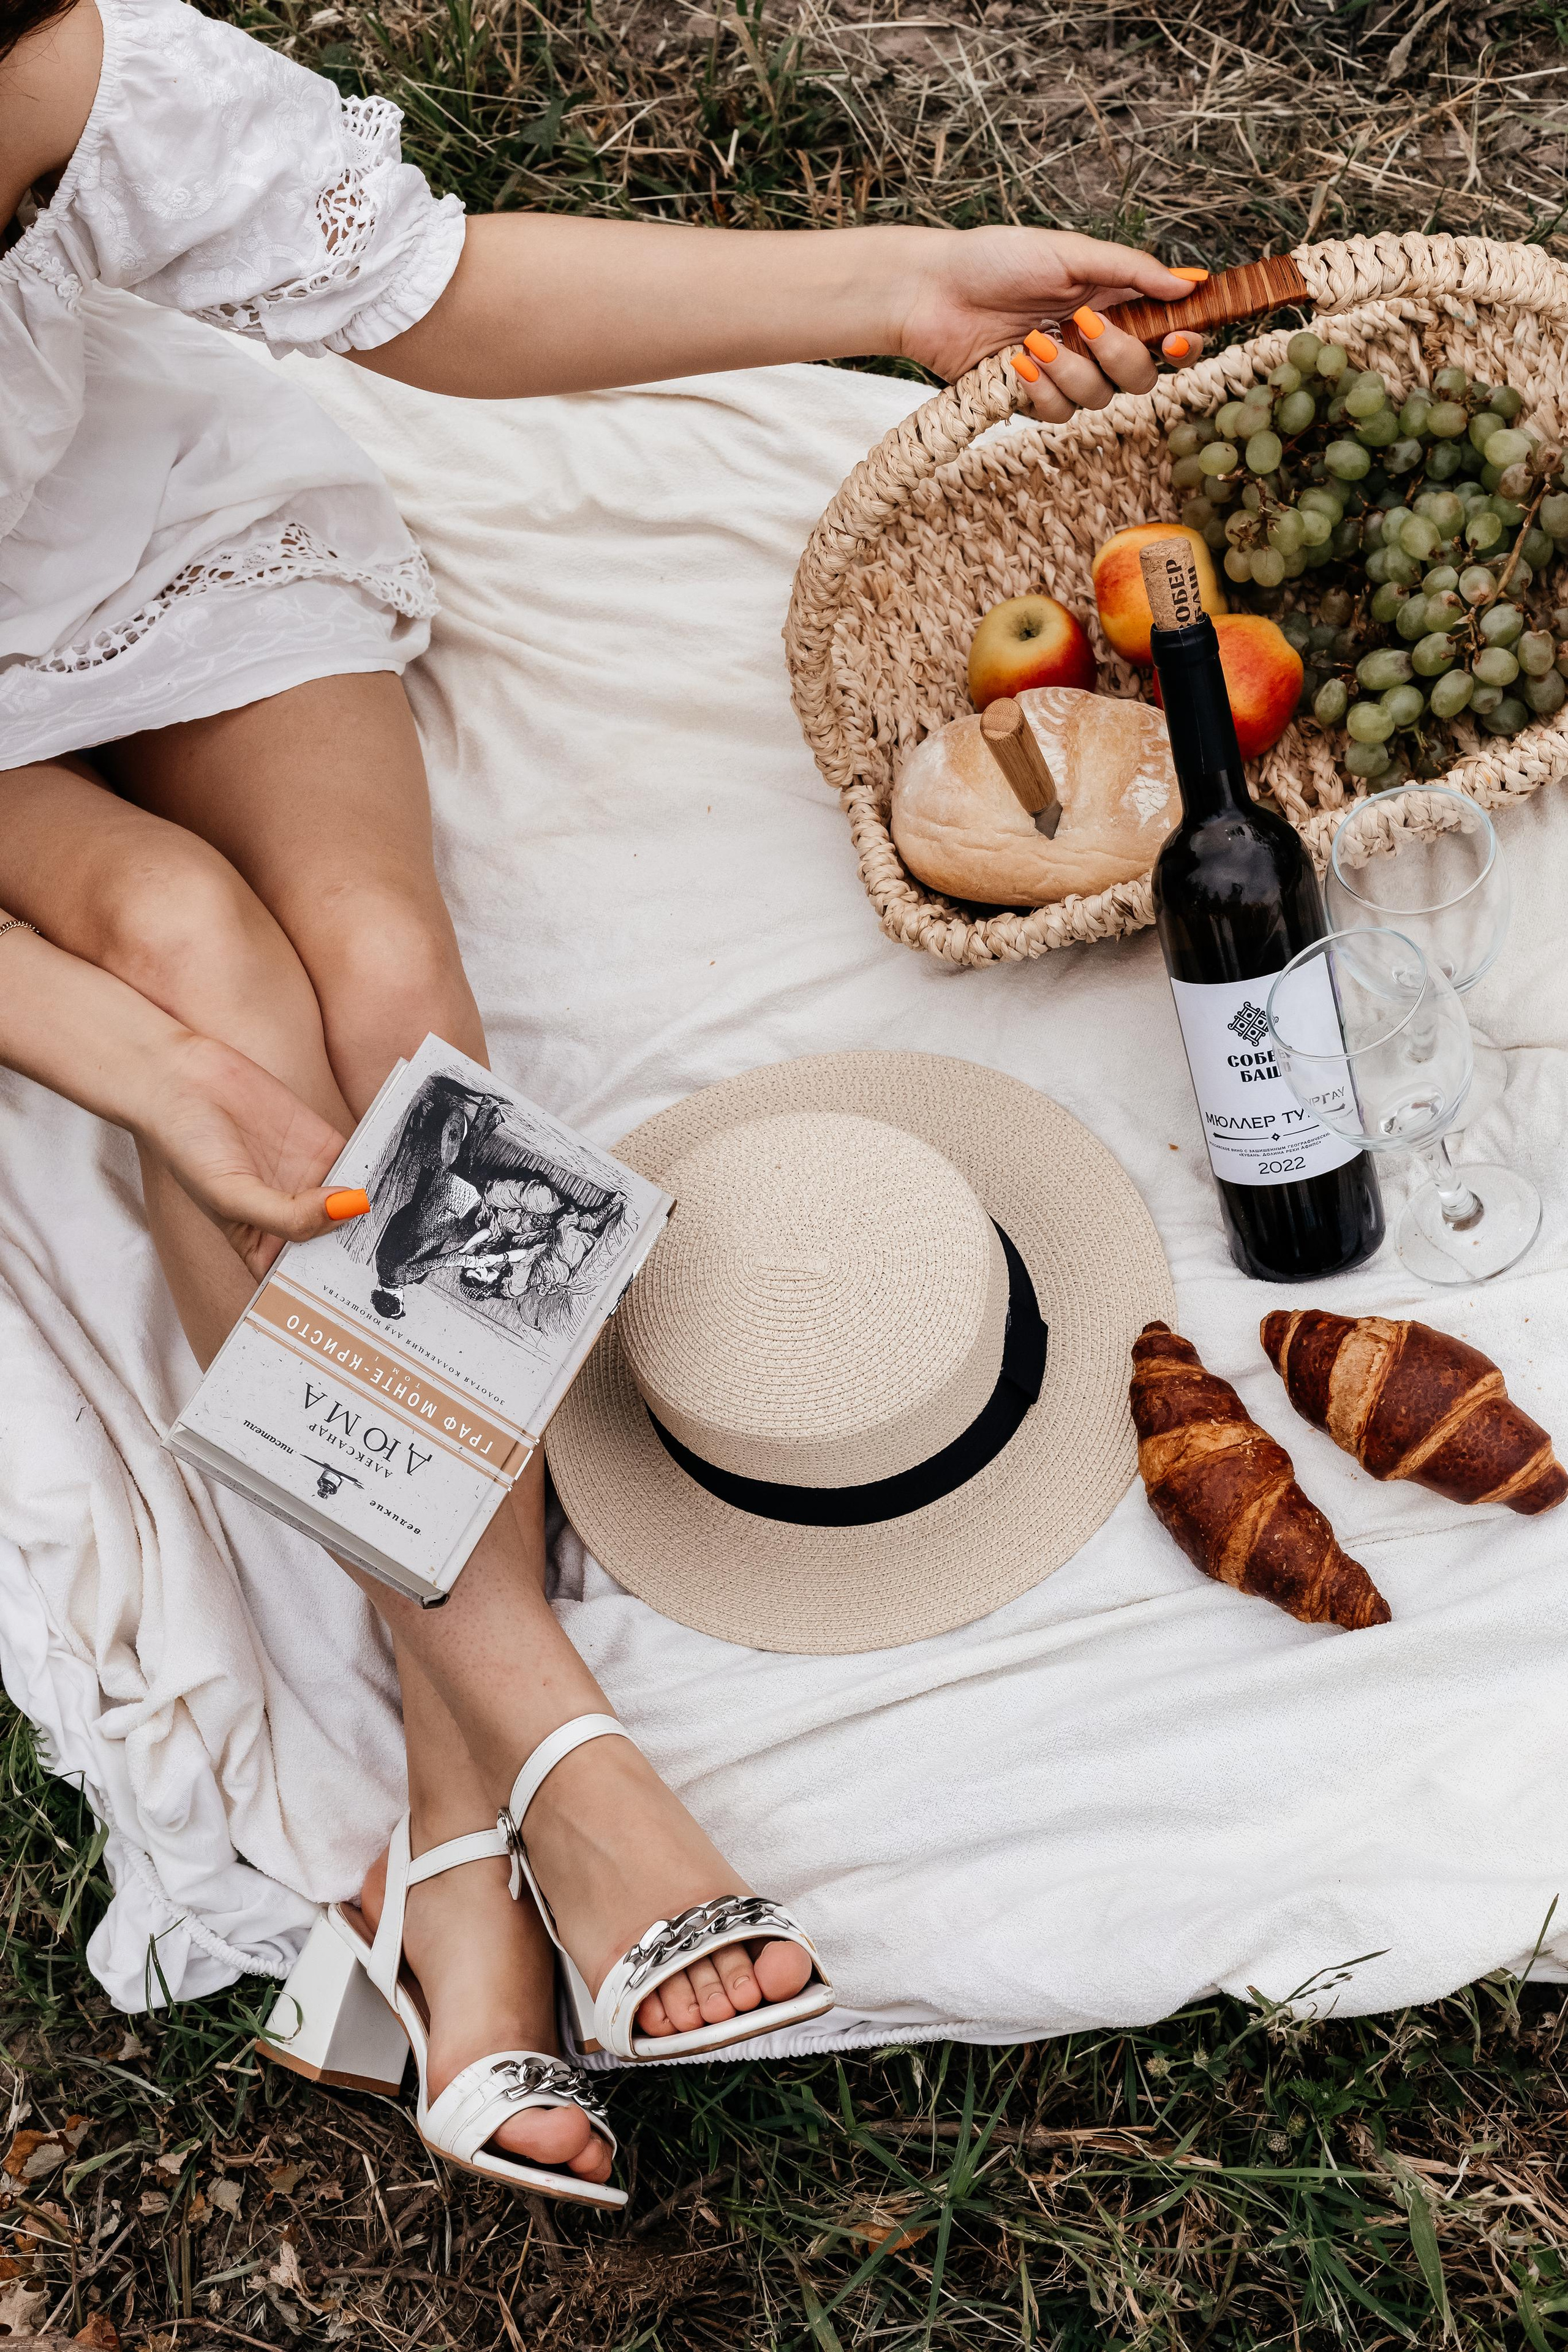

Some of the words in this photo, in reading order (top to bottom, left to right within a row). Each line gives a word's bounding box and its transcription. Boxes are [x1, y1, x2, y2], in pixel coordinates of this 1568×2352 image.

[1166, 559, 1192, 628] ОБЕР
[1205, 1111, 1275, 1129] МЮЛЛЕР
[1258, 1156, 1306, 1174] 2022
[323, 1285, 382, 1324] ЮНОШЕСТВА
[385, 1324, 404, 1339] ДЛЯ
[287, 1314, 437, 1419] МОНТЕ-КРИСТО
[405, 1338, 461, 1378] КОЛЛЕКЦИЯ
[392, 1367, 421, 1389] ТОМ
[464, 1376, 505, 1405] ЗОЛОТАЯ
[243, 1419, 294, 1455] писатели
[304, 1382, 432, 1476] ДЮМА
[443, 1416, 494, 1455] ГРАФ
[308, 1422, 393, 1479] АЛЕКСАНДР
[369, 1499, 421, 1536] великие
